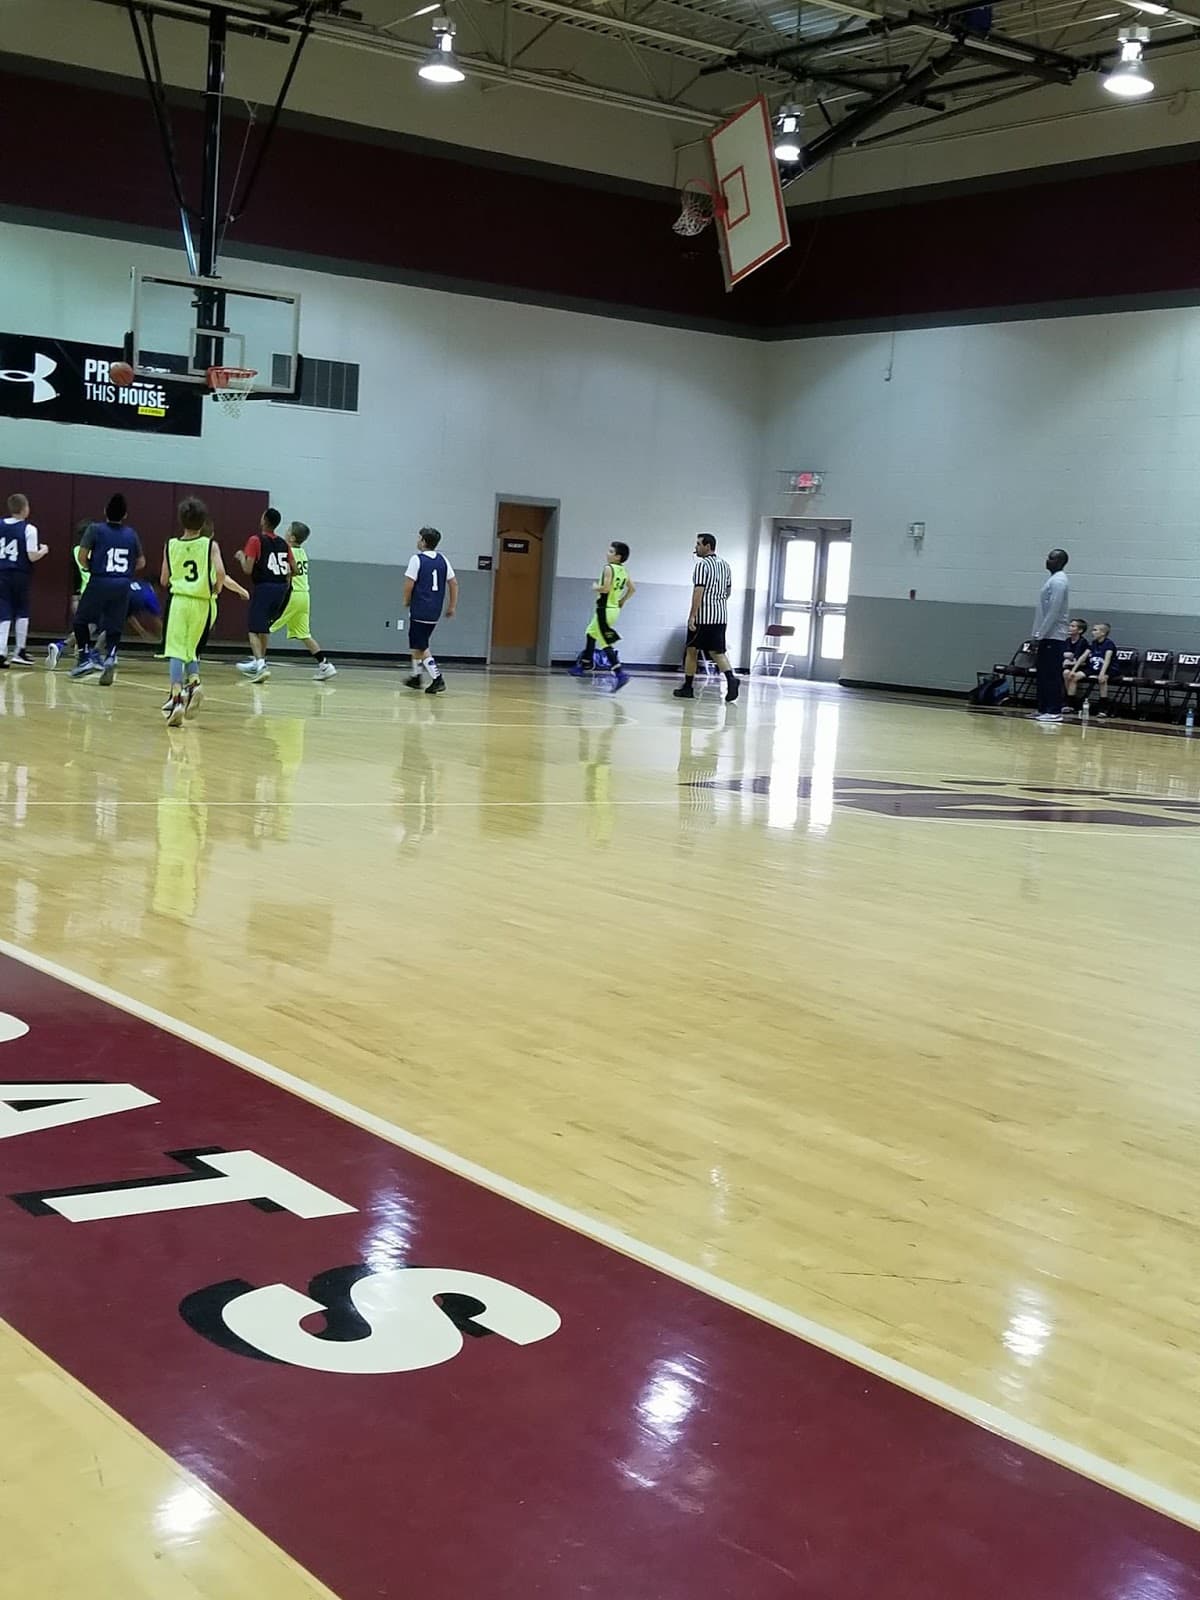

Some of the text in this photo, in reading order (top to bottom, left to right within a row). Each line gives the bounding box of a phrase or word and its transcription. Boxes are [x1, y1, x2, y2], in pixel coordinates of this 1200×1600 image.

[84, 383, 170, 409] THIS HOUSE.
[105, 547, 129, 573] 15
[182, 560, 199, 583] 3
[267, 552, 292, 576] 45
[430, 568, 439, 592] 1
[0, 1011, 561, 1374] ATS
